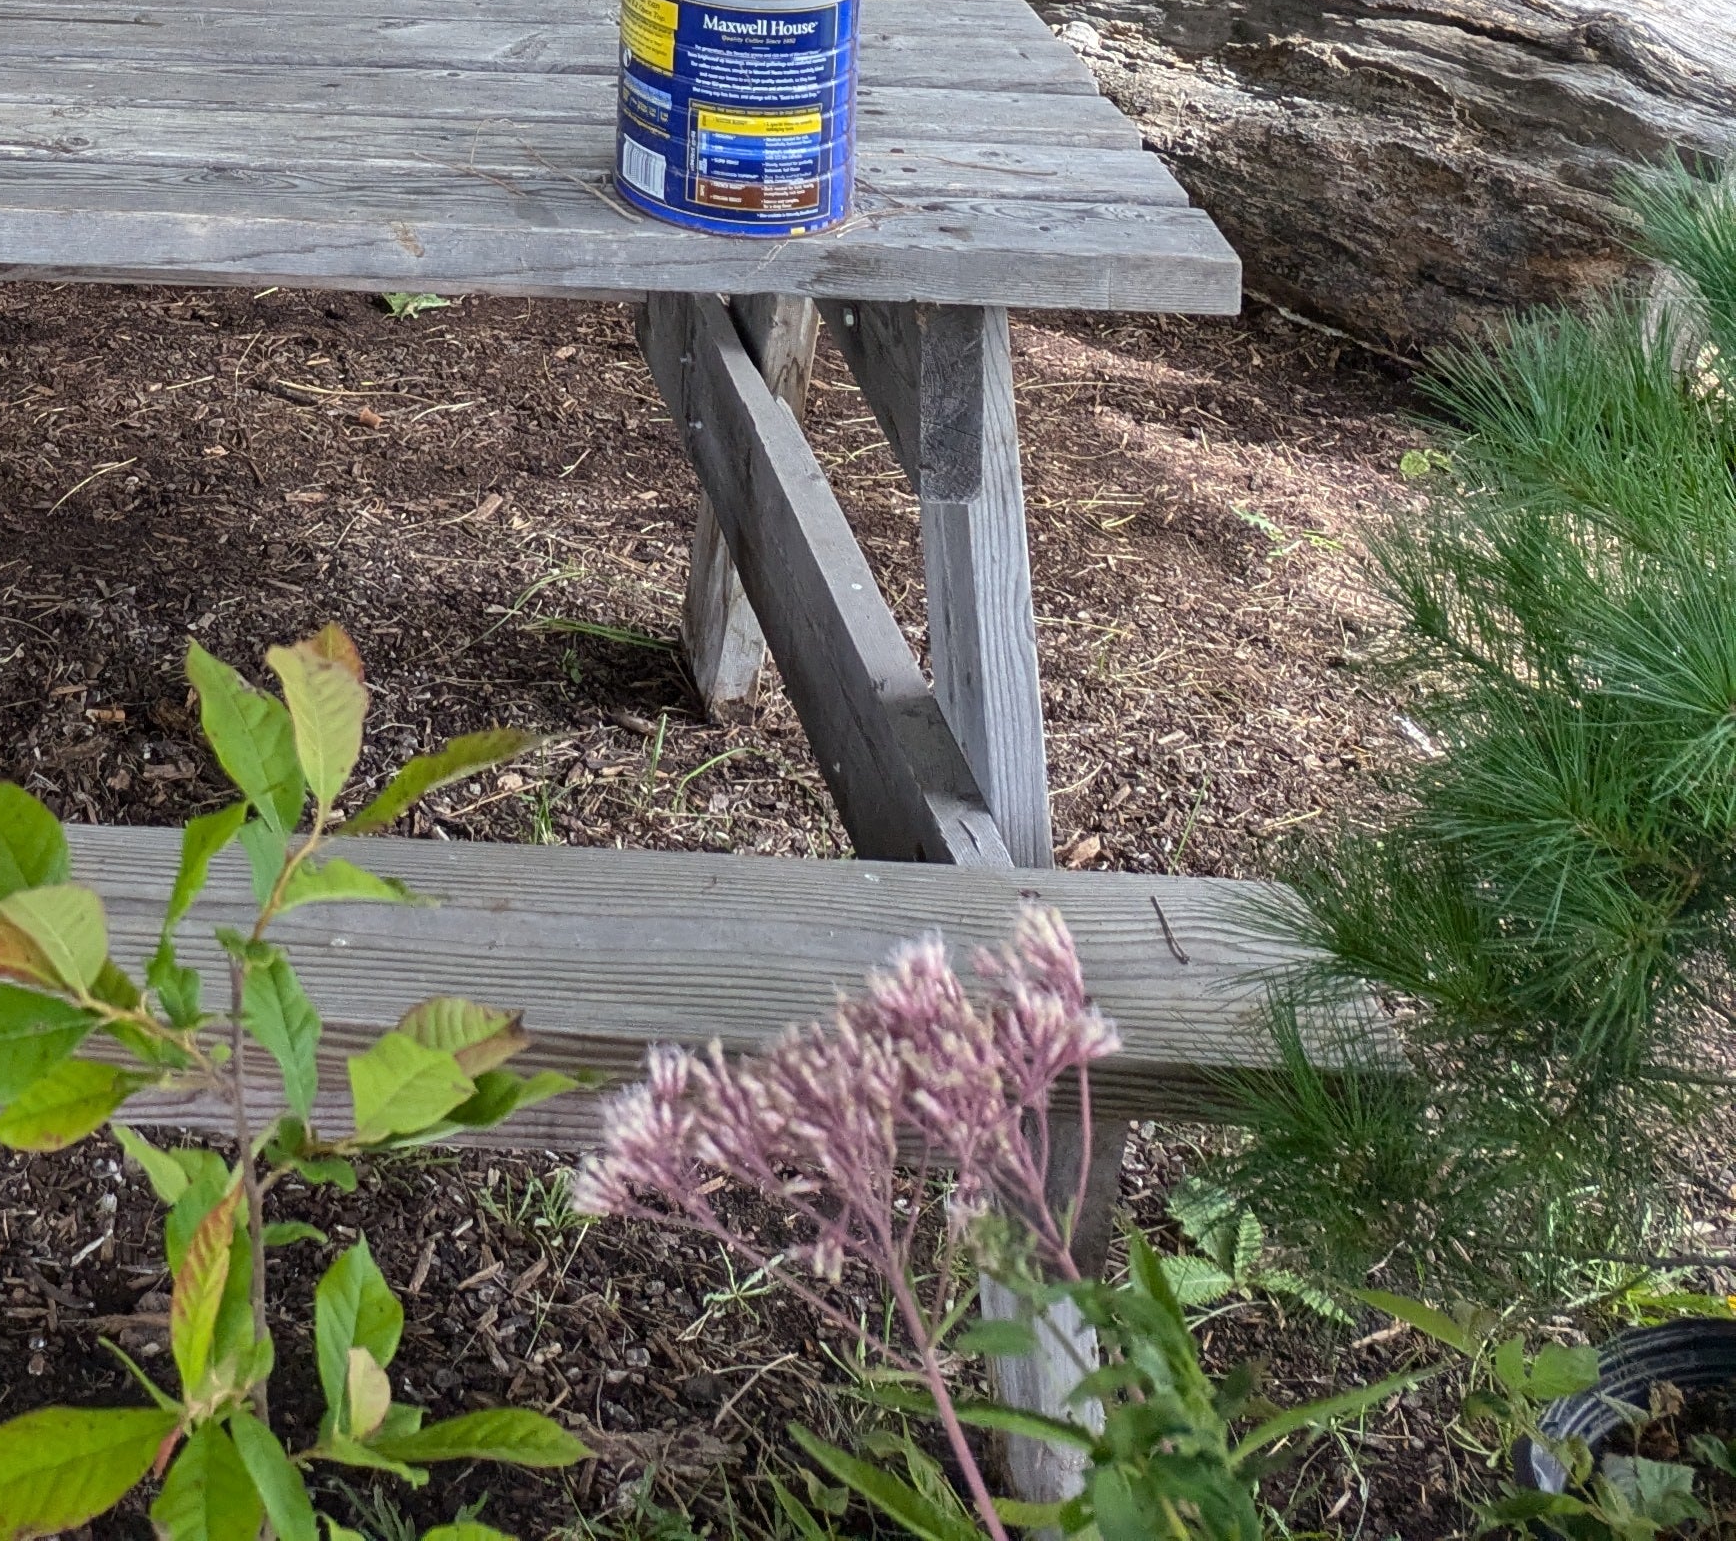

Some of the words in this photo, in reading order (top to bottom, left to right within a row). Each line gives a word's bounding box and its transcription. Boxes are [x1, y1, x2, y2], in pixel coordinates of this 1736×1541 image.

[703, 13, 767, 36] Maxwell
[770, 20, 816, 36] House
[721, 34, 743, 43] Quality
[745, 36, 764, 44] Coffee
